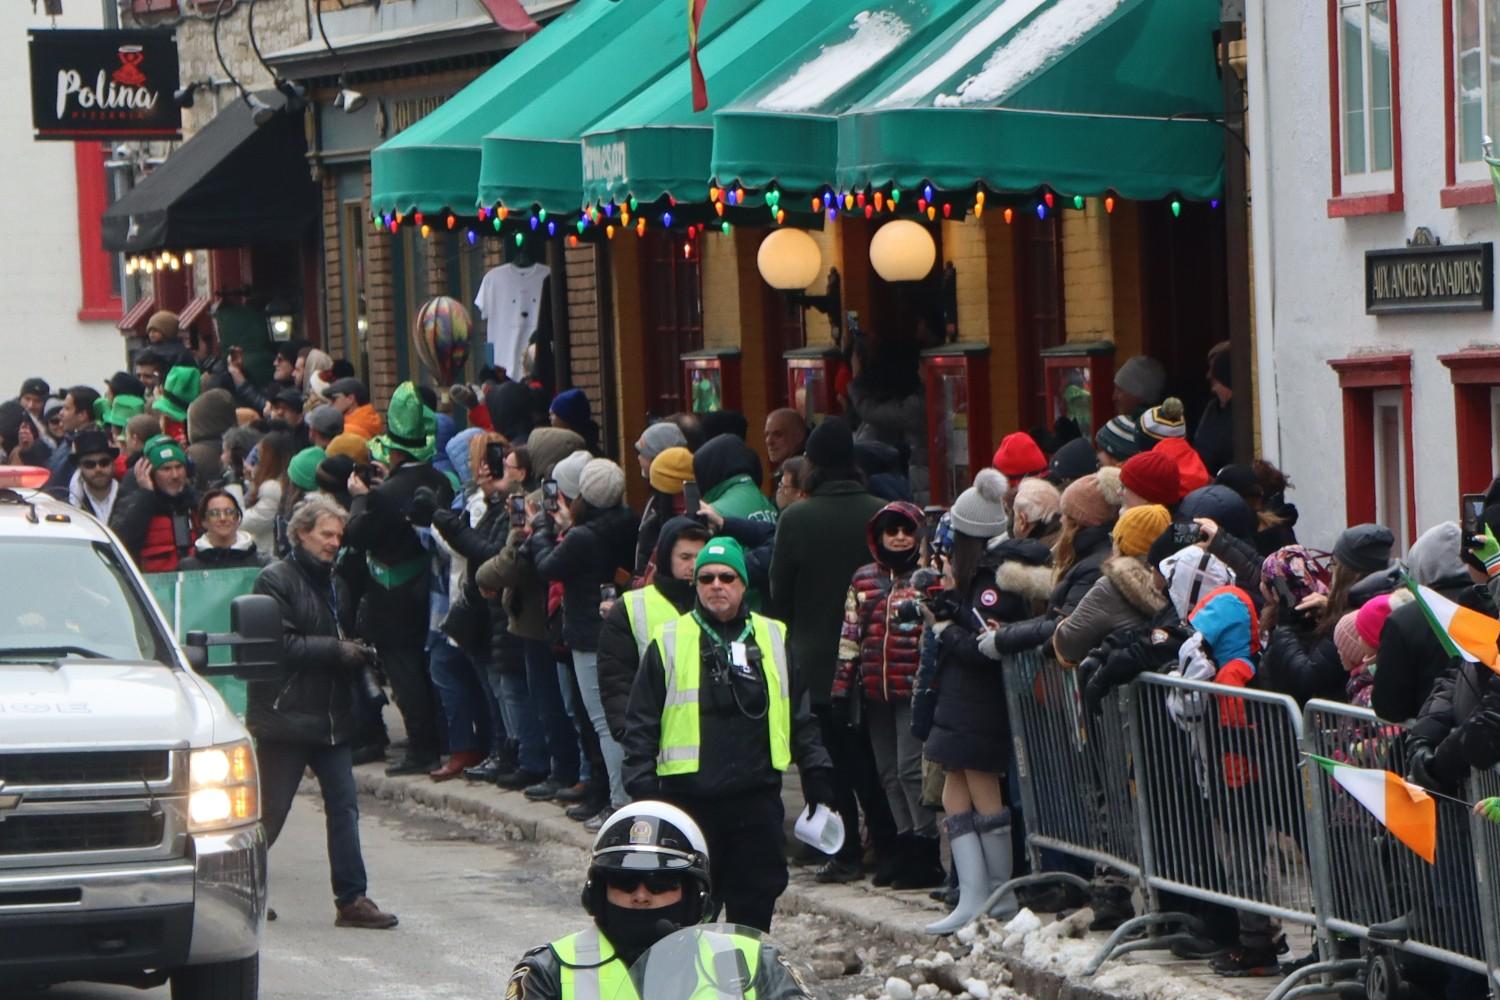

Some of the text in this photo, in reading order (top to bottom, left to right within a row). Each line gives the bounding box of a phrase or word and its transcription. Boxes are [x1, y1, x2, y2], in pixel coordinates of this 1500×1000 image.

[56, 69, 158, 120] Polina
[1373, 260, 1482, 298] AUX ANCIENS CANADIENS
